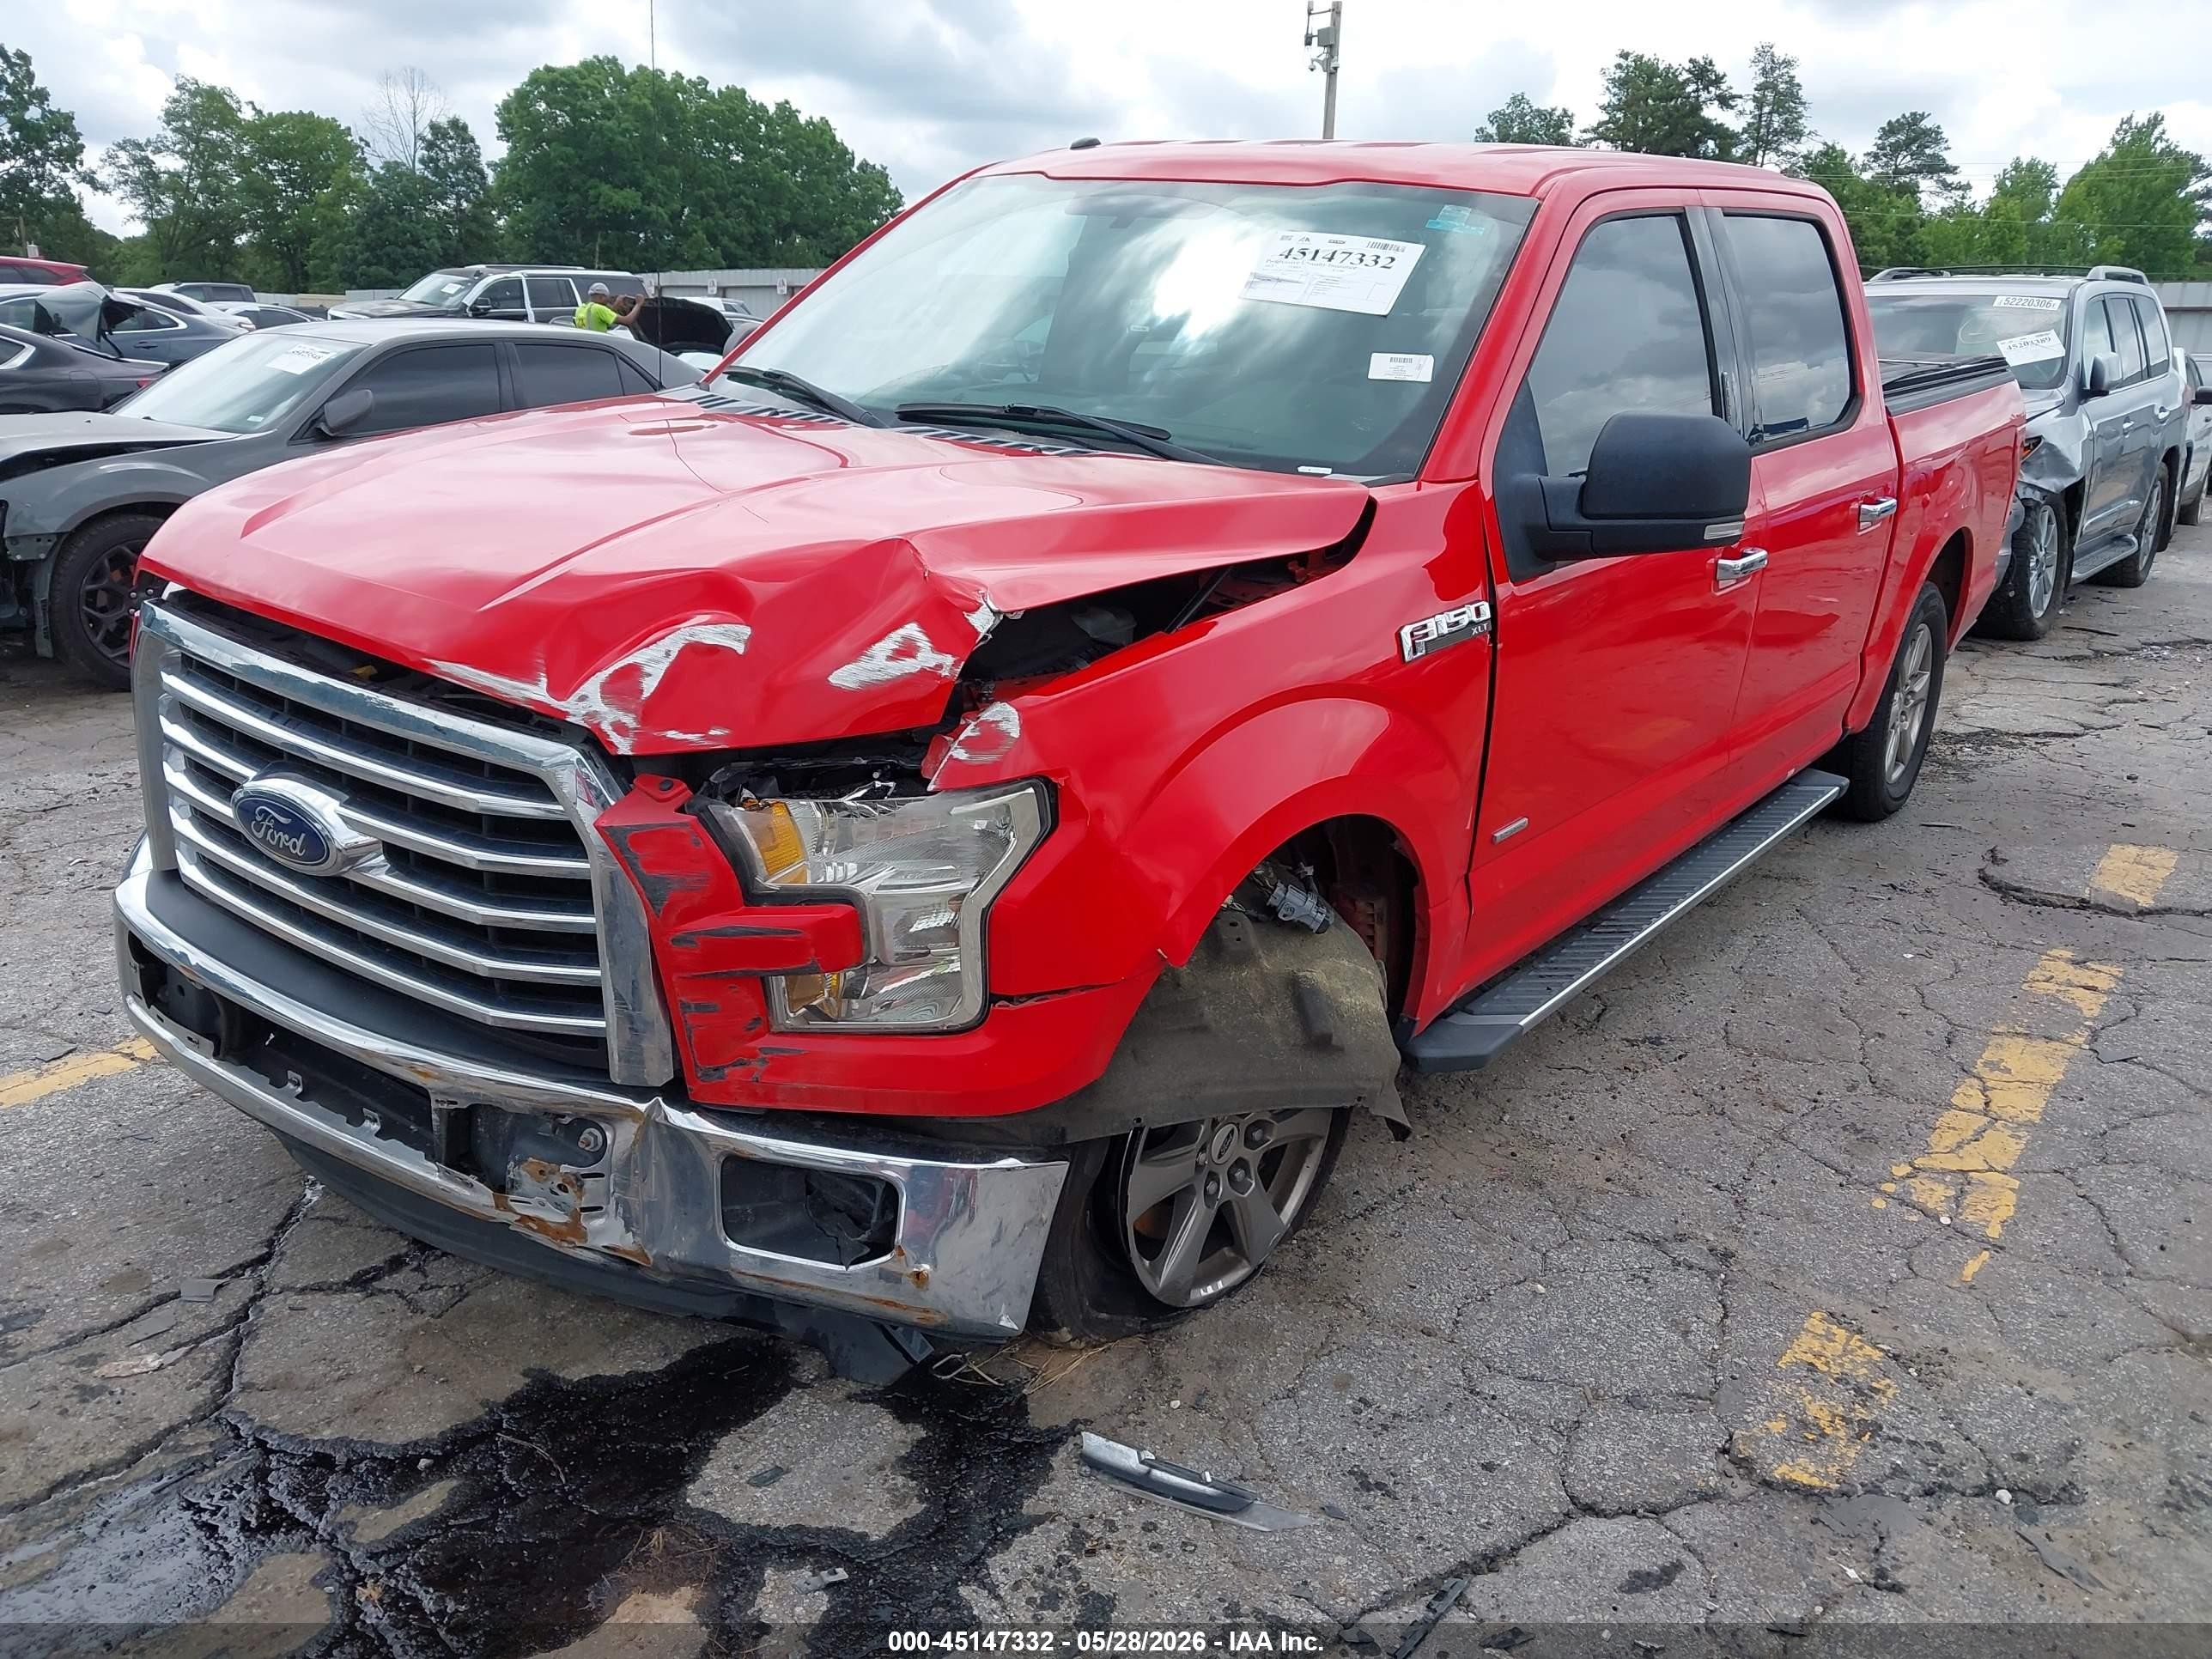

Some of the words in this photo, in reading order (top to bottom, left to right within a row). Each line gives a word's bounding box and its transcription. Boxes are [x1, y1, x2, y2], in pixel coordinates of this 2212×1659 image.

[1279, 246, 1396, 270] 45147332
[2003, 297, 2053, 309] 52220306
[1471, 622, 1490, 636] XLT
[250, 805, 307, 857] Ford
